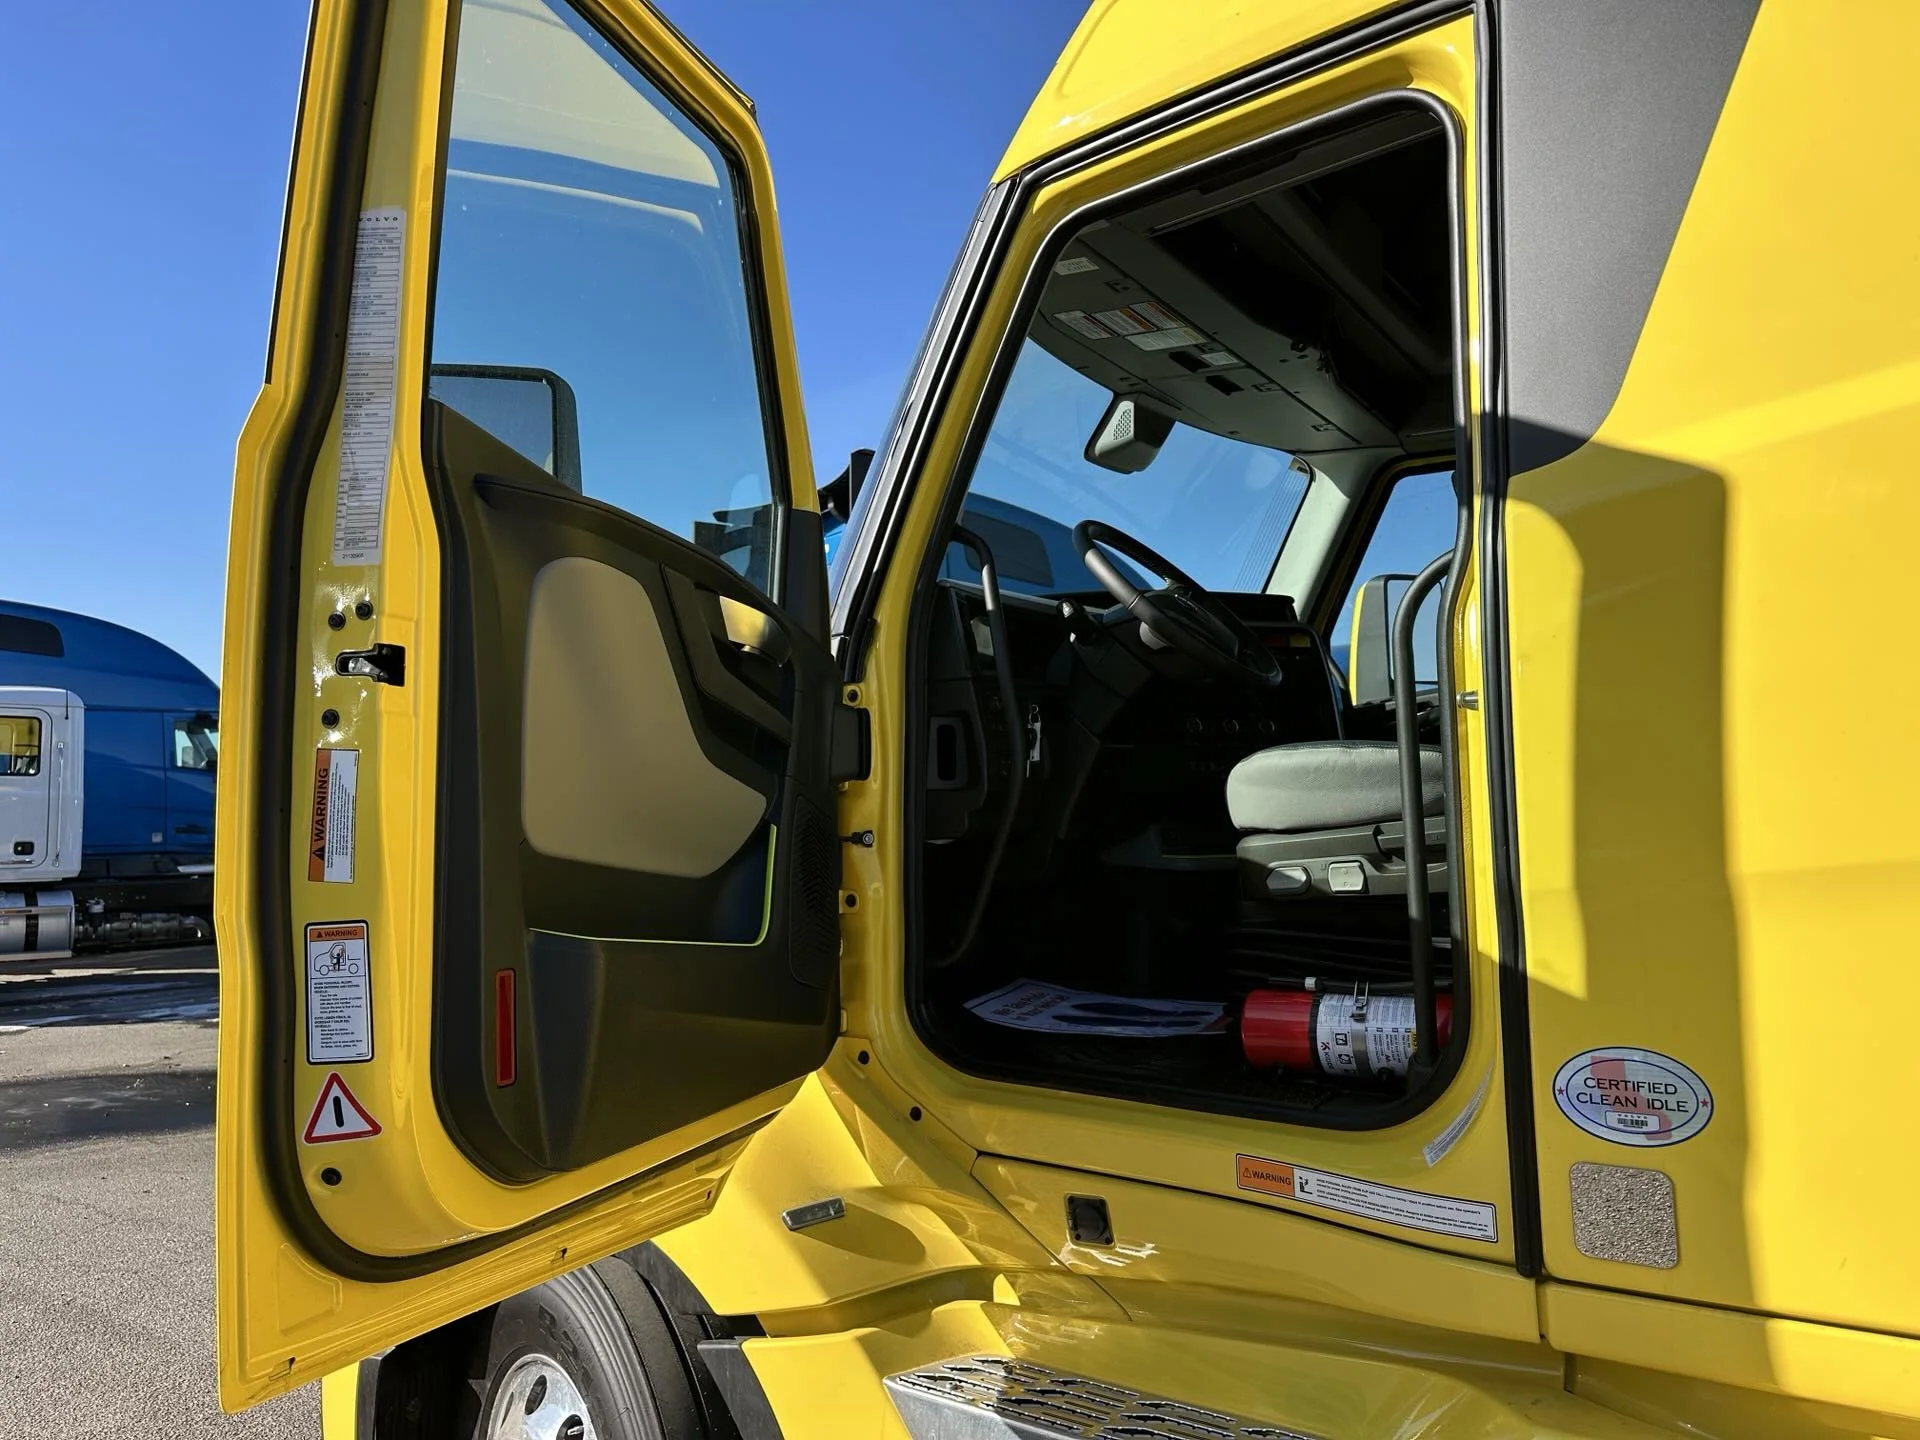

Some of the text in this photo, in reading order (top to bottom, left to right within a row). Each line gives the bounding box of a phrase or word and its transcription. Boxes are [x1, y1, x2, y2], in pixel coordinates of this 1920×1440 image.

[313, 768, 329, 842] WARNING
[324, 929, 358, 938] WARNING
[1583, 1077, 1678, 1095] CERTIFIED
[1576, 1092, 1689, 1113] CLEAN IDLE
[1251, 1170, 1292, 1187] WARNING
